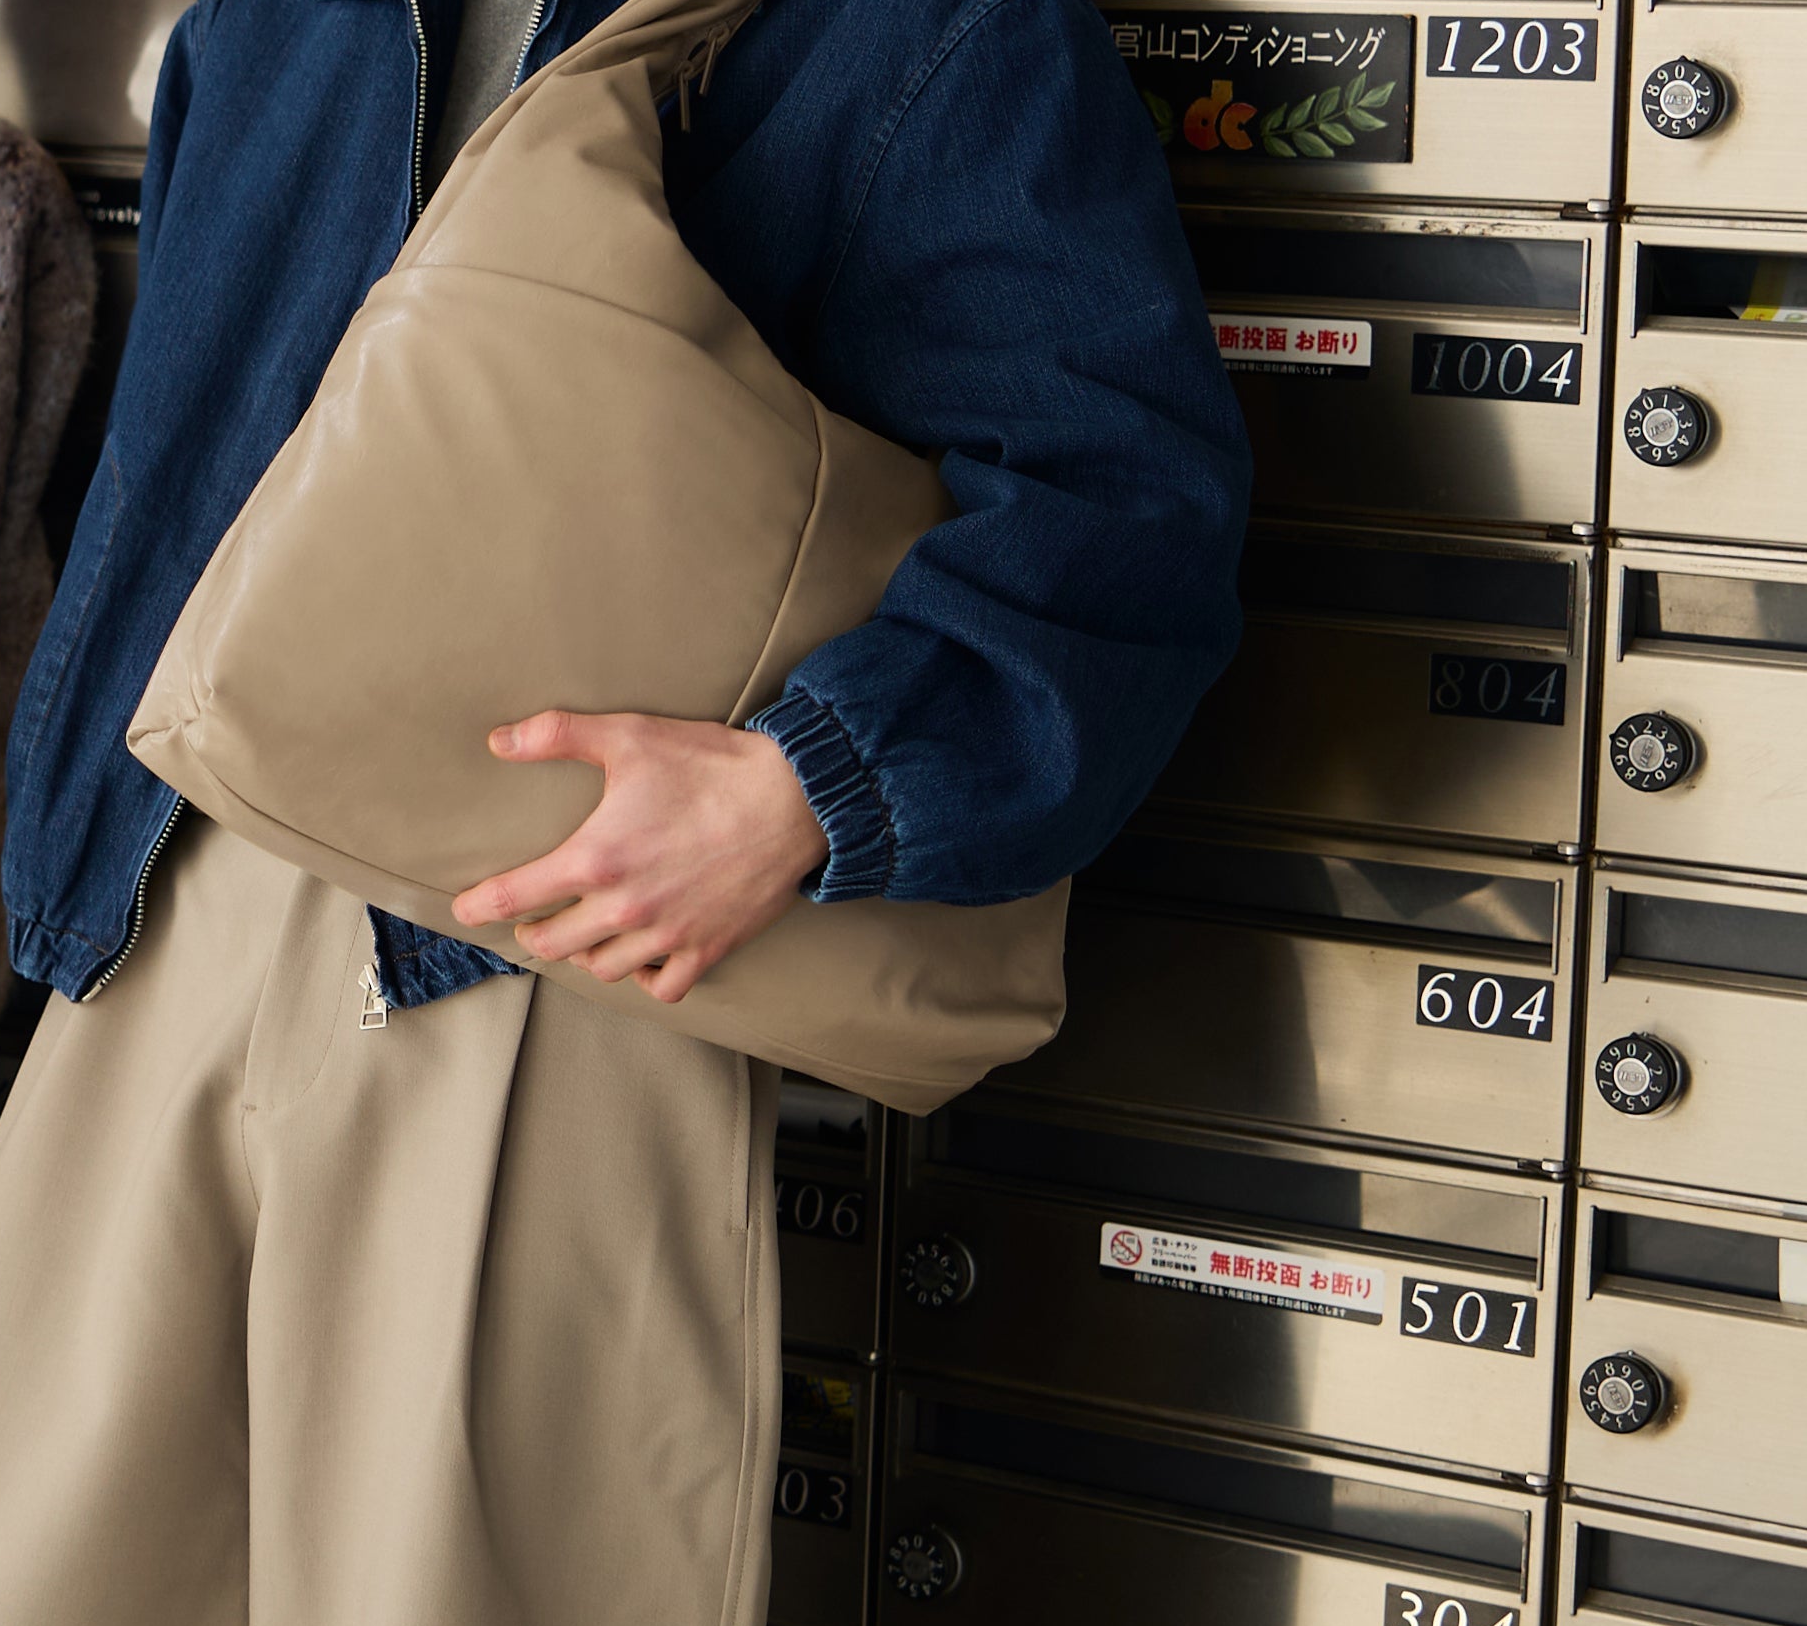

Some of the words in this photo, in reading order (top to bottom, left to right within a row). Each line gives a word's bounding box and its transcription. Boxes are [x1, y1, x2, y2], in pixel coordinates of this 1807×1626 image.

[1110, 24, 1385, 70] 官山コンディショニング
[1436, 22, 1585, 75] 1203
[1212, 325, 1287, 352] 断投函
[1295, 330, 1357, 355] お断り
[1423, 340, 1573, 400] 1004
[1434, 660, 1559, 717] 804
[1419, 973, 1546, 1036] 604
[1209, 1250, 1302, 1288] 無断投函
[1309, 1269, 1372, 1299] お断り
[1403, 1286, 1531, 1354] 501
[780, 1469, 846, 1520] 03
